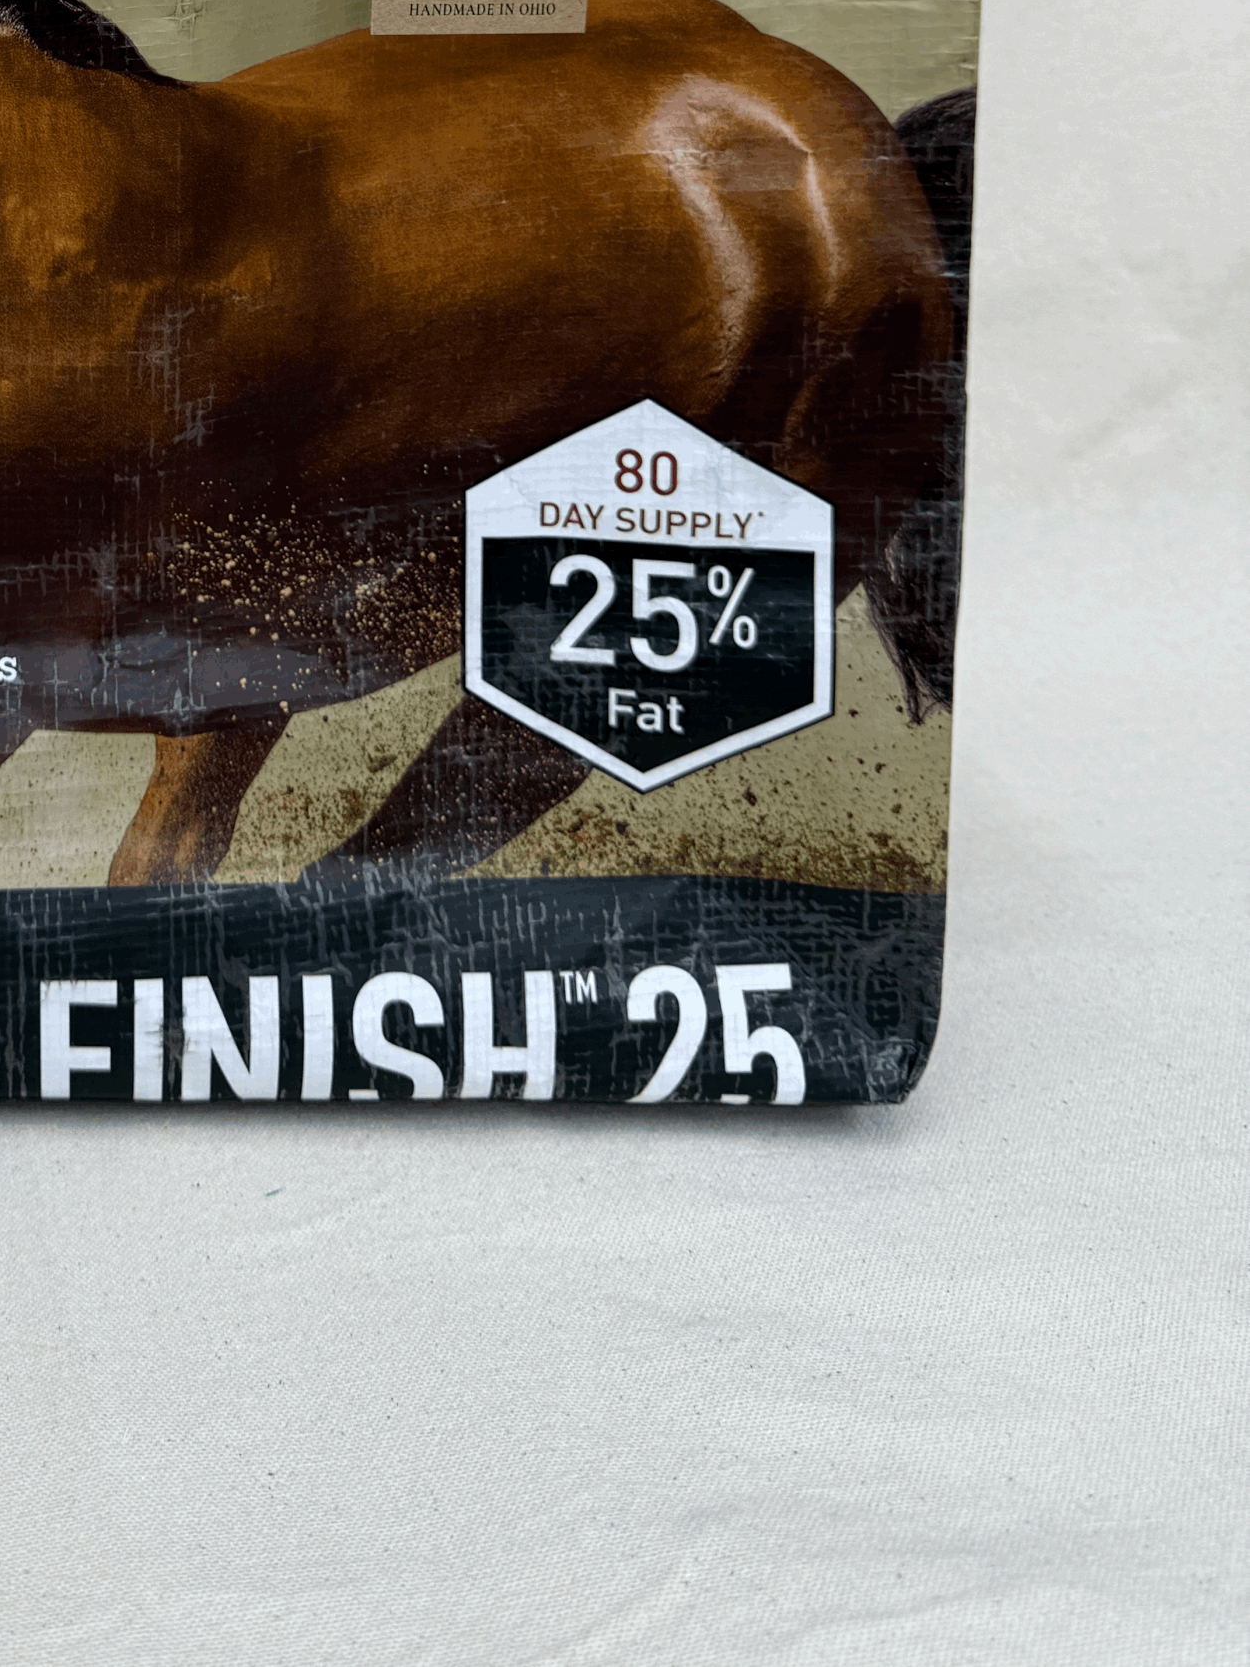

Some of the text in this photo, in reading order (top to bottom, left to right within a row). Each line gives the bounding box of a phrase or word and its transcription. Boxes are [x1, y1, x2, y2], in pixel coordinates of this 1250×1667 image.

[409, 2, 556, 16] HANDMADE IN OHIO
[614, 448, 679, 496] 80
[539, 502, 605, 530] DAY
[549, 553, 758, 674] 25%
[607, 687, 686, 733] Fat
[625, 961, 808, 1105] 25
